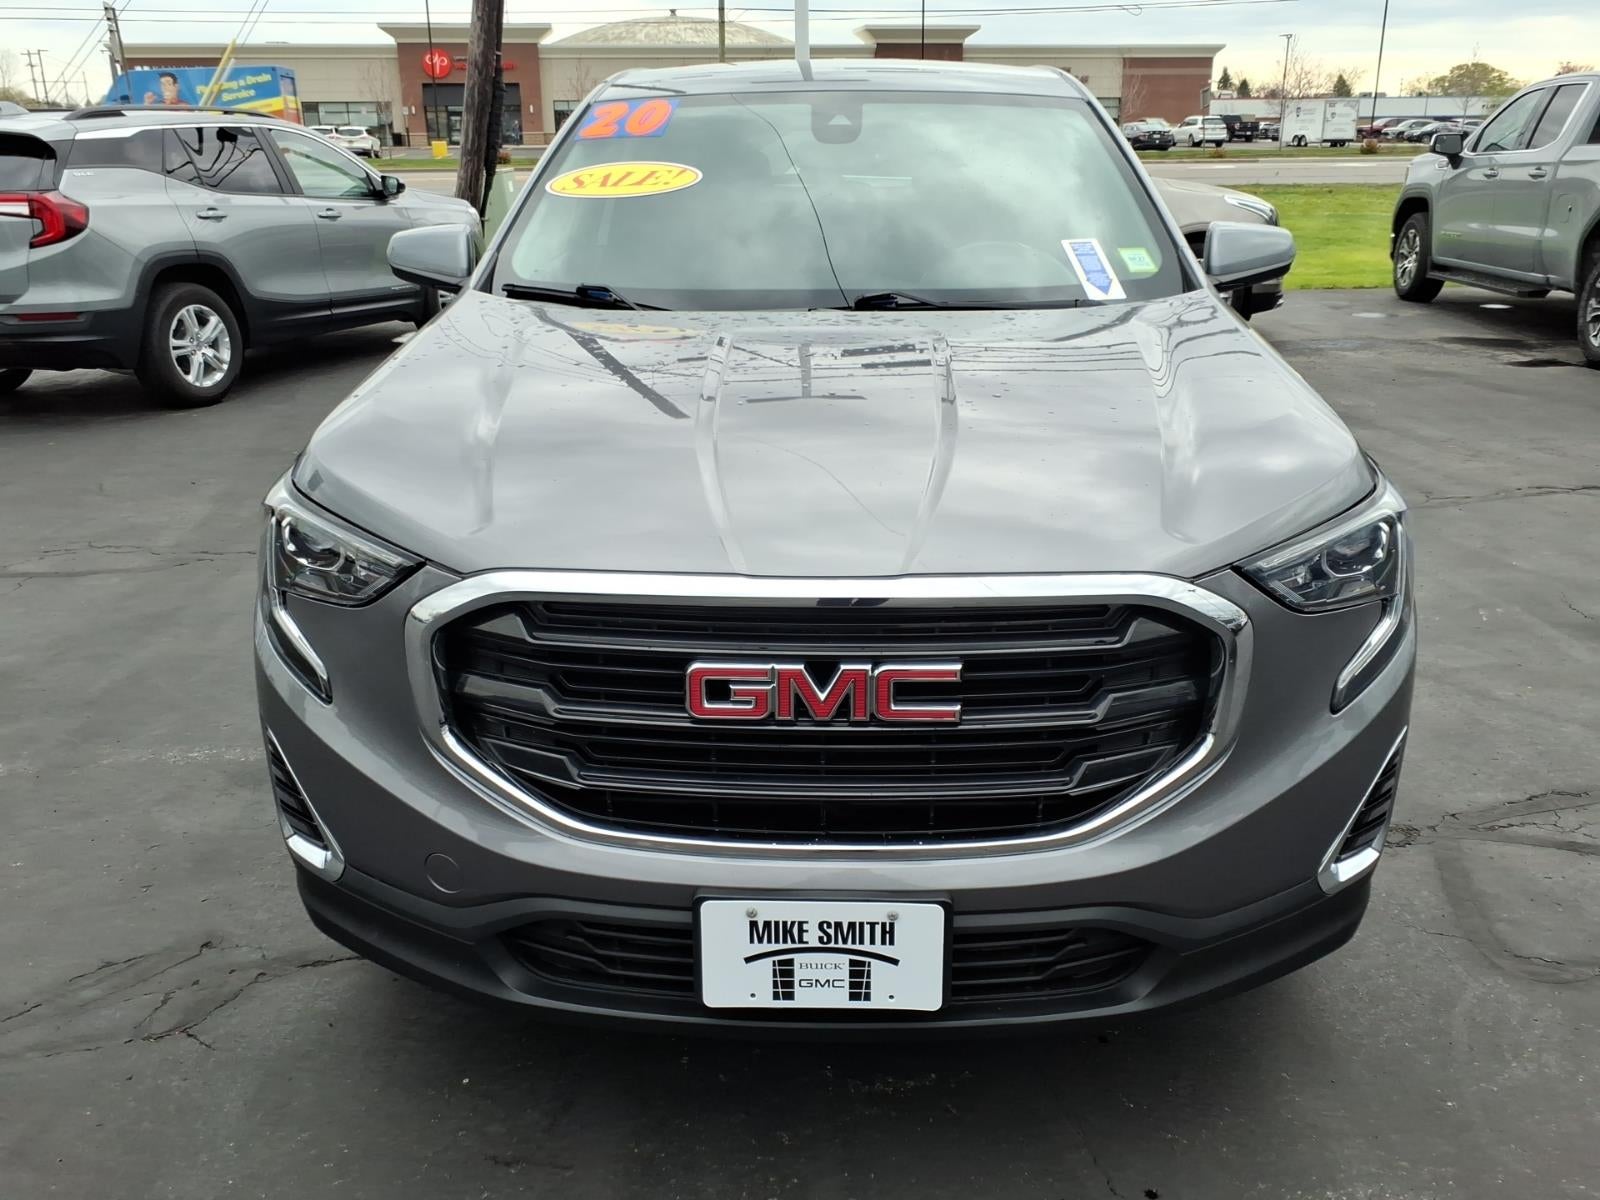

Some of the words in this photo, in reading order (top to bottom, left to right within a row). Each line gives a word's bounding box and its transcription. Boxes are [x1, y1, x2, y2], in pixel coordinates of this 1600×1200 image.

[246, 73, 272, 85] Drain
[222, 89, 256, 102] Service
[578, 98, 673, 139] 20
[561, 168, 689, 191] SALE!
[686, 661, 962, 723] GMC
[749, 920, 809, 945] MIKE
[817, 920, 896, 946] SMITH
[799, 962, 844, 970] BUICK
[798, 978, 845, 988] GMC
